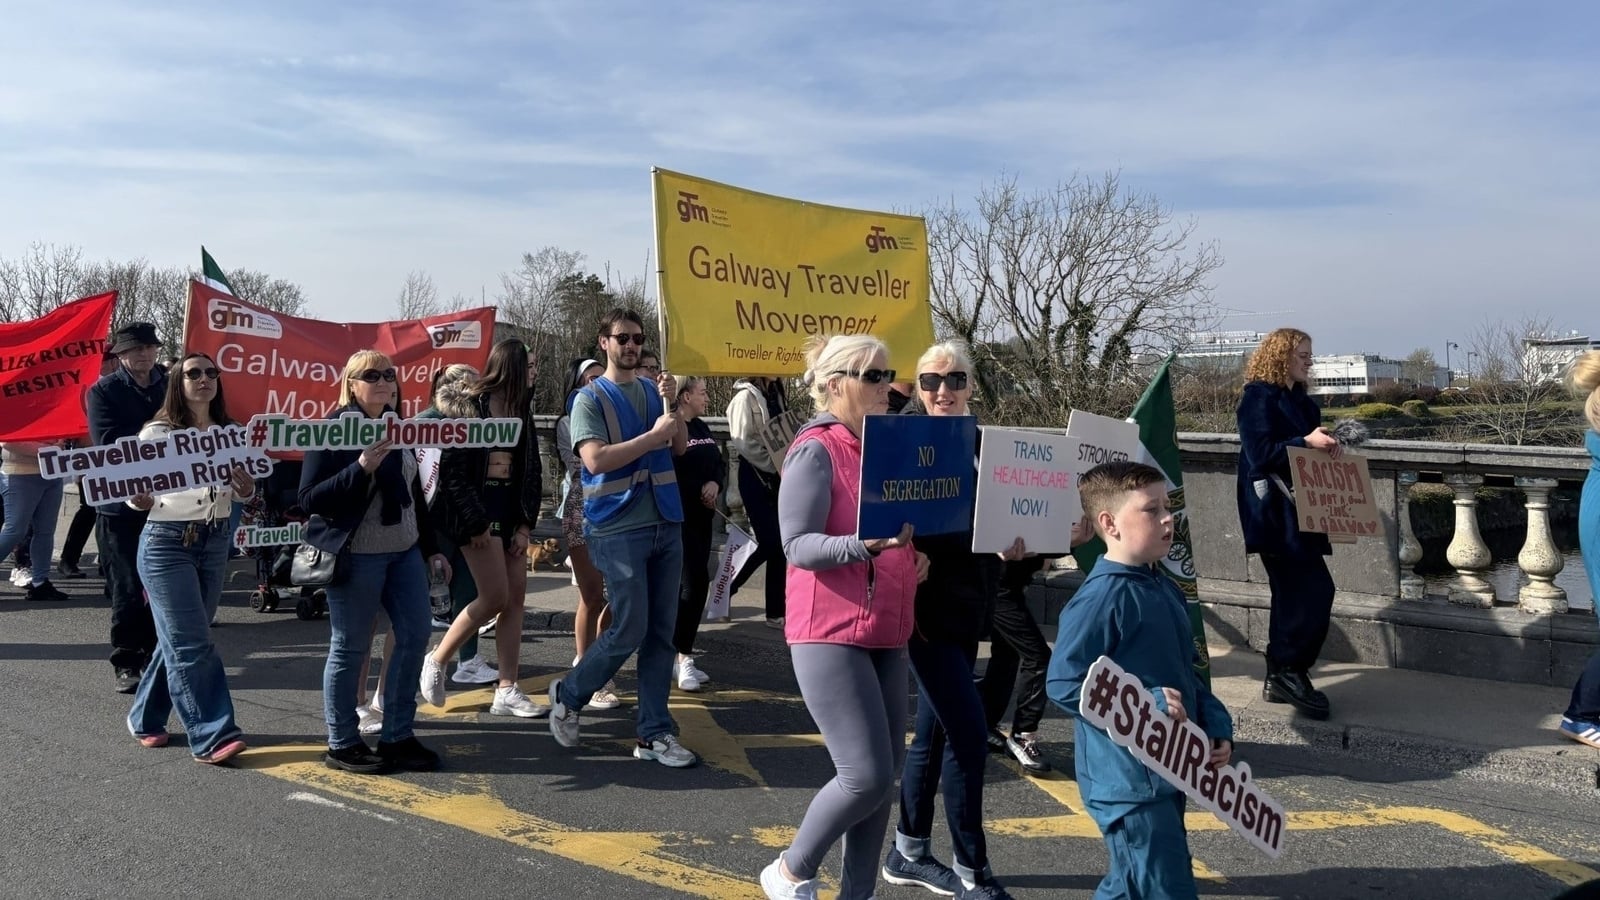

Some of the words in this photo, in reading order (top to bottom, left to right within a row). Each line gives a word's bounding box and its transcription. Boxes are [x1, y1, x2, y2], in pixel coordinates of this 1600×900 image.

[689, 245, 791, 298] Galway
[797, 264, 911, 300] Traveller
[735, 299, 877, 335] Movement
[216, 343, 347, 388] Galway
[725, 342, 772, 361] Traveller
[250, 416, 519, 448] #Travellerhomesnow
[39, 437, 168, 476] Traveller
[174, 428, 247, 458] Rights
[917, 446, 935, 467] NO
[1013, 440, 1053, 462] TRANS
[88, 469, 188, 503] Human
[190, 456, 270, 486] Rights
[881, 477, 961, 502] SEGREGATION
[992, 466, 1070, 489] HEALTHCARE
[1295, 456, 1364, 494] RACISM
[1010, 497, 1049, 518] NOW!
[713, 574, 729, 605] Rights
[1088, 667, 1282, 850] #StallRacism
